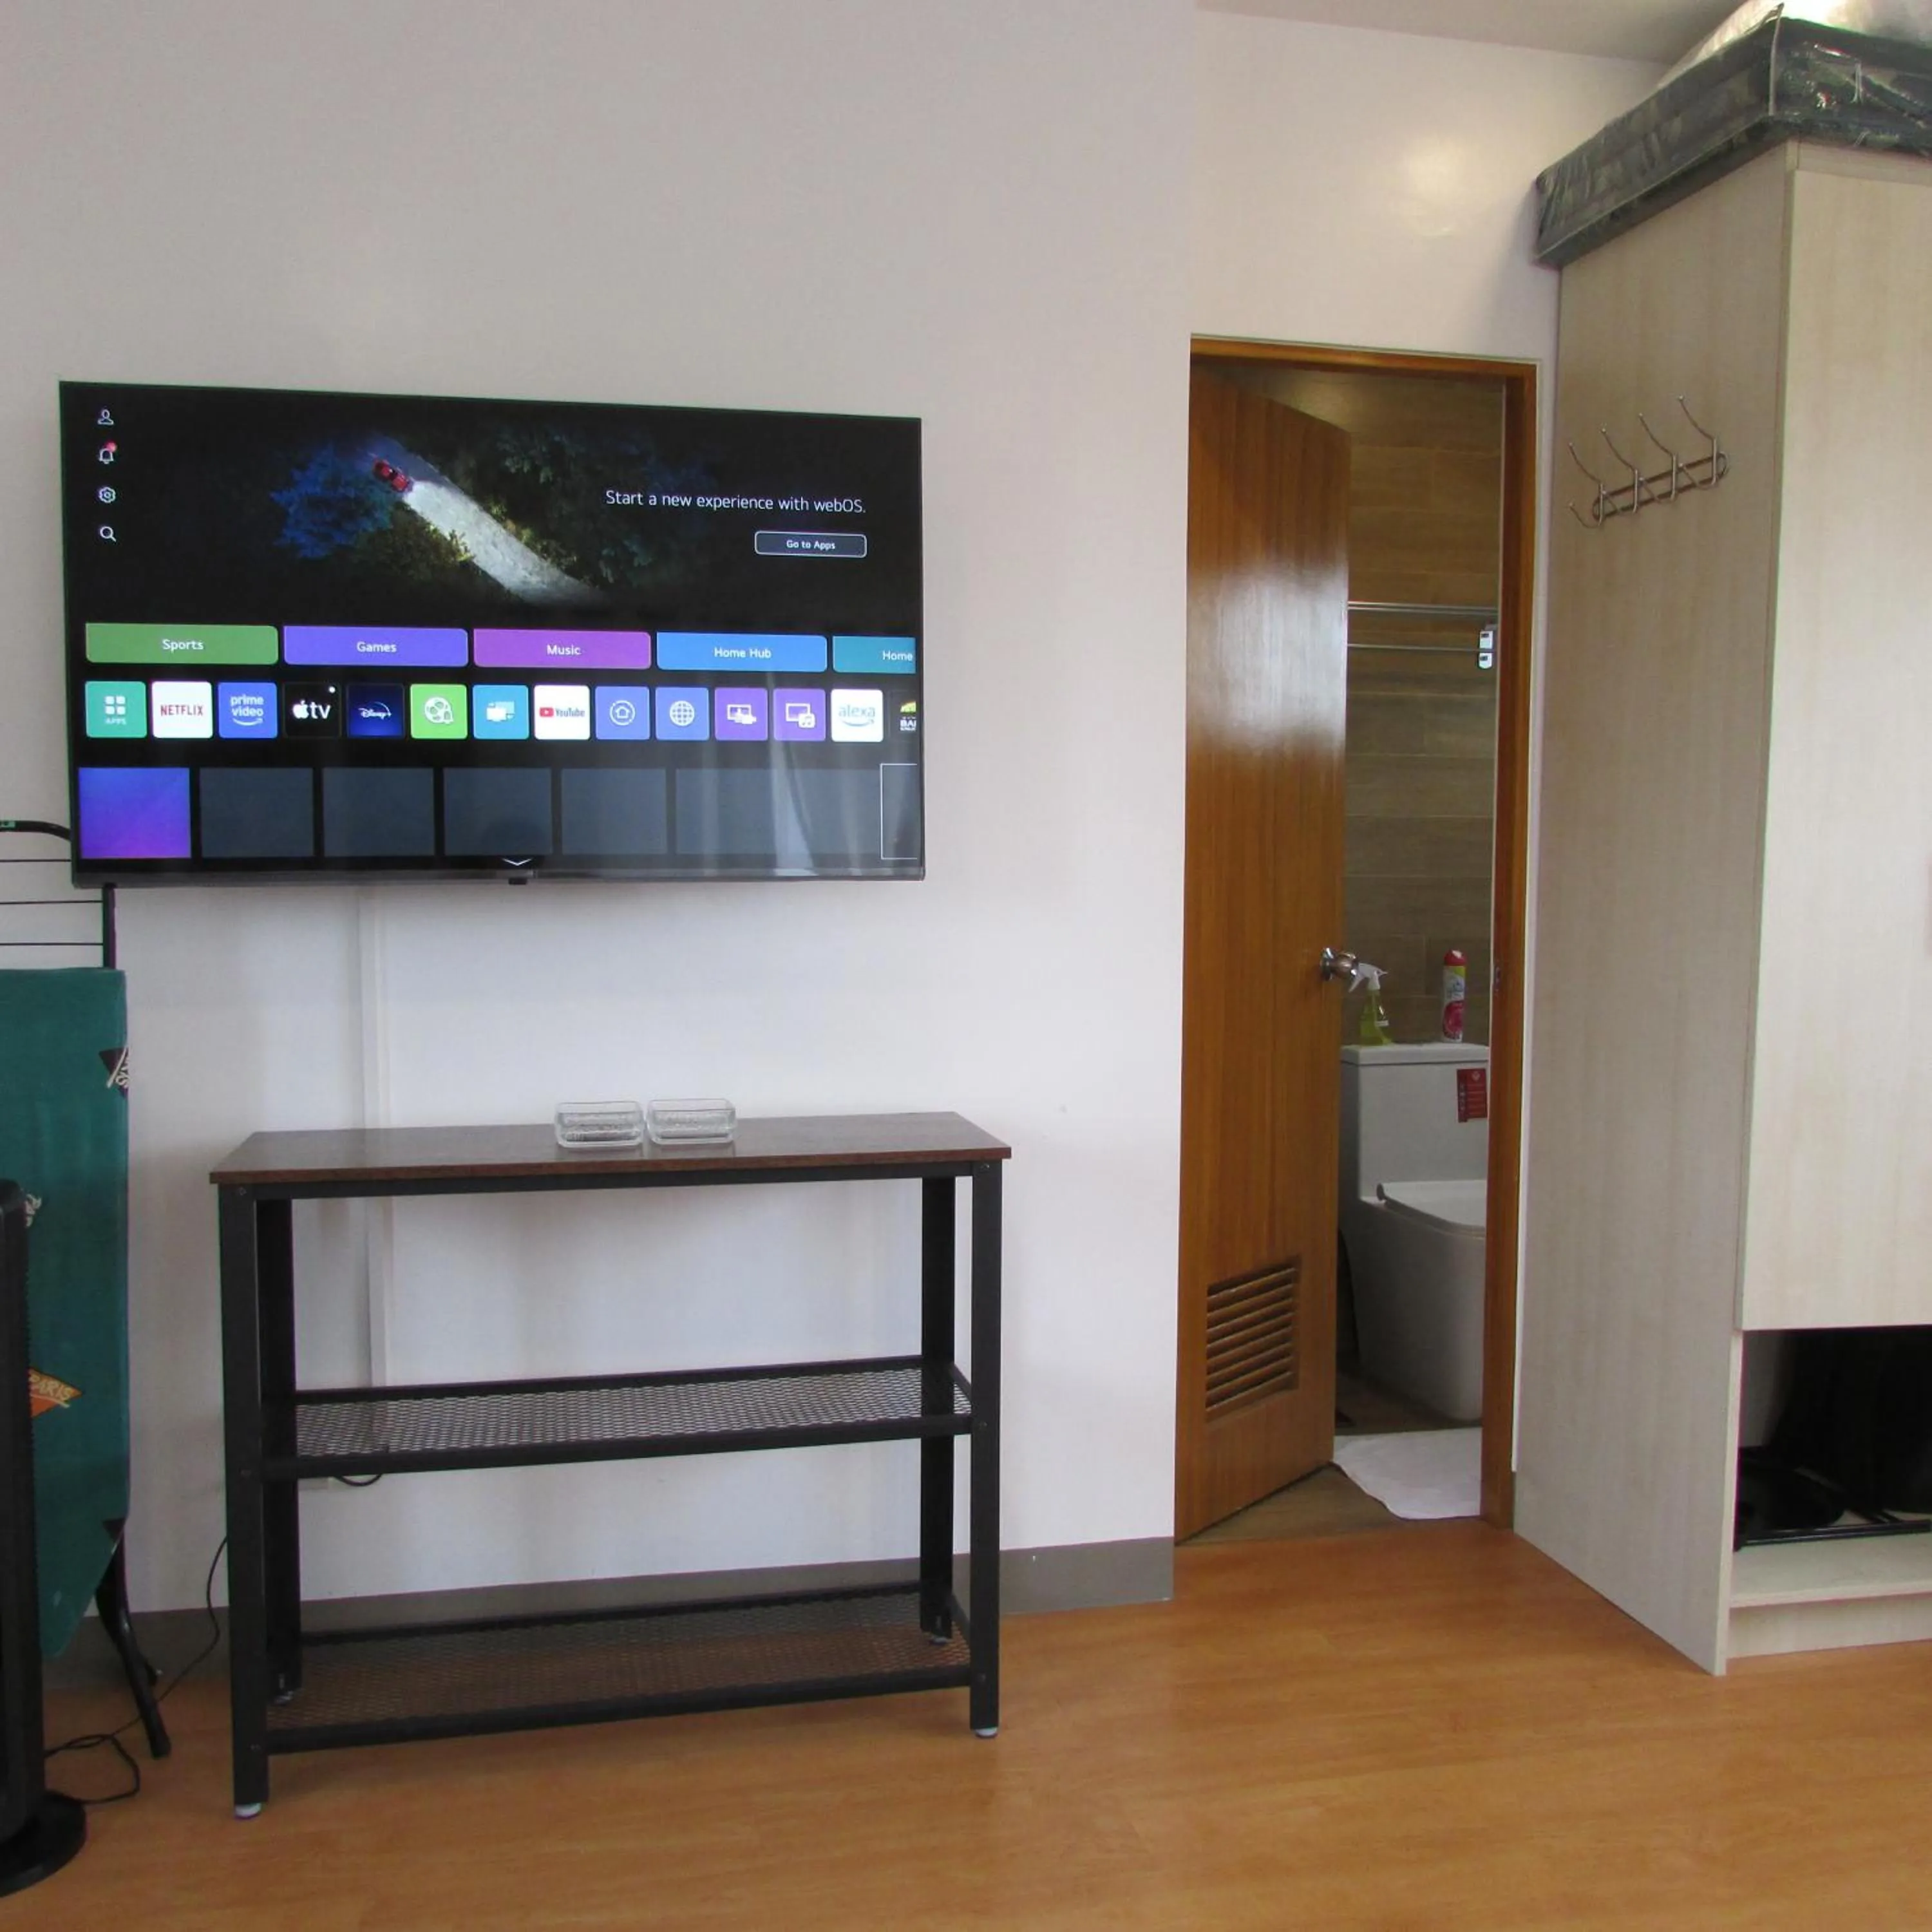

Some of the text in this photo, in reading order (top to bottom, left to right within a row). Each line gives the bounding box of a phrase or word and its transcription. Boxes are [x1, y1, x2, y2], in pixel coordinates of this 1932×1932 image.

[606, 491, 866, 513] Start a new experience with webOS.
[786, 539, 799, 549] Go
[814, 540, 836, 550] Apps
[162, 639, 204, 652] Sports
[357, 641, 397, 653] Games
[547, 644, 582, 656] Music
[714, 647, 772, 659] Home Hub
[882, 650, 913, 661] Home
[230, 694, 264, 707] prime
[160, 705, 204, 717] NETFLIX
[232, 706, 264, 717] video
[310, 701, 330, 719] tv
[556, 706, 585, 717] YouTube
[838, 704, 876, 717] alexa
